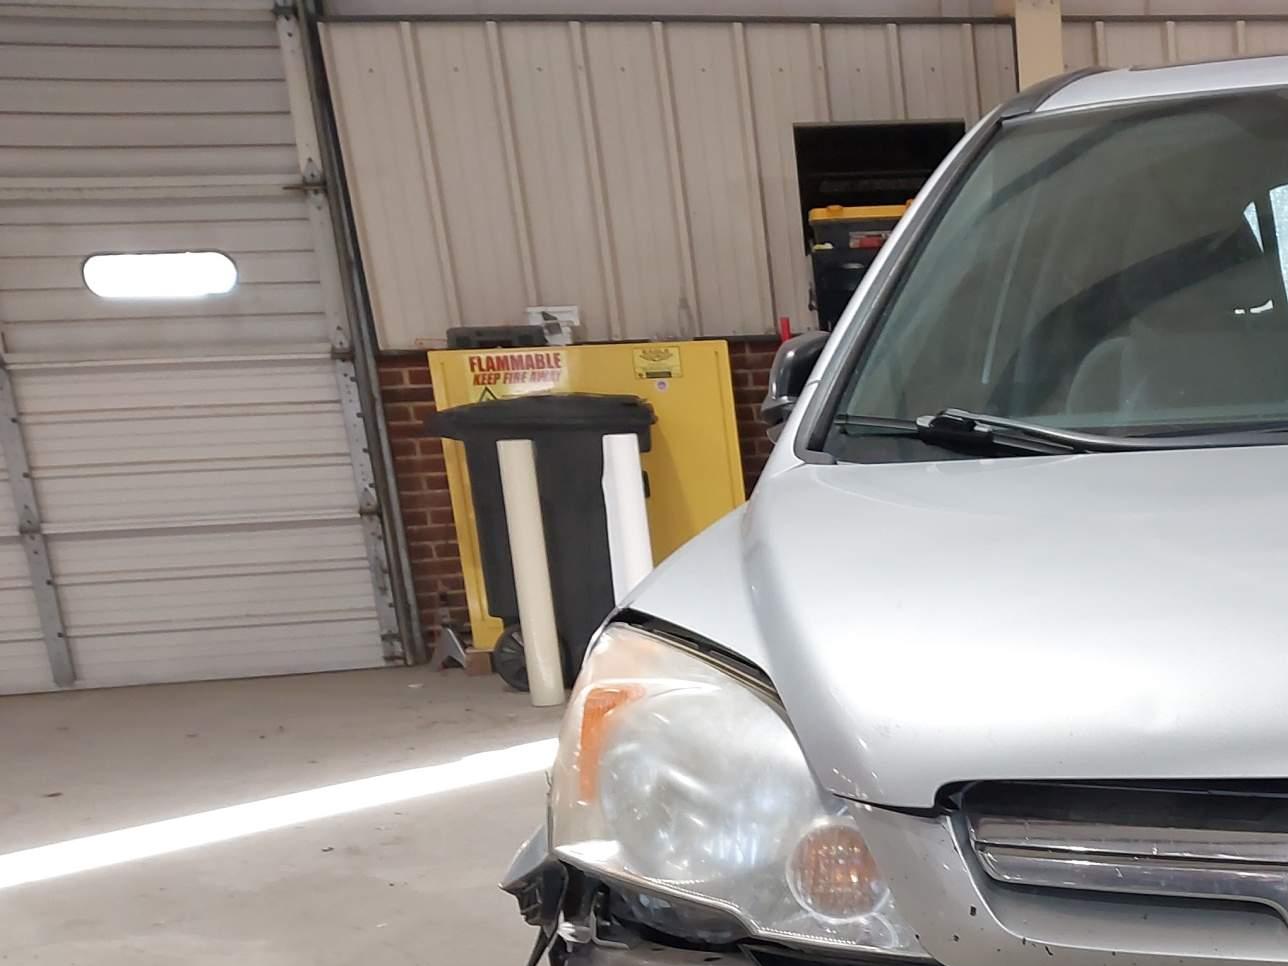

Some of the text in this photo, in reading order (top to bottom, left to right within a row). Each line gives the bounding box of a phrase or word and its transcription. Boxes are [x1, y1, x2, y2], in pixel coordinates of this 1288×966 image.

[468, 353, 561, 372] FLAMMABLE
[473, 372, 501, 386] KEEP
[503, 371, 528, 385] FIRE
